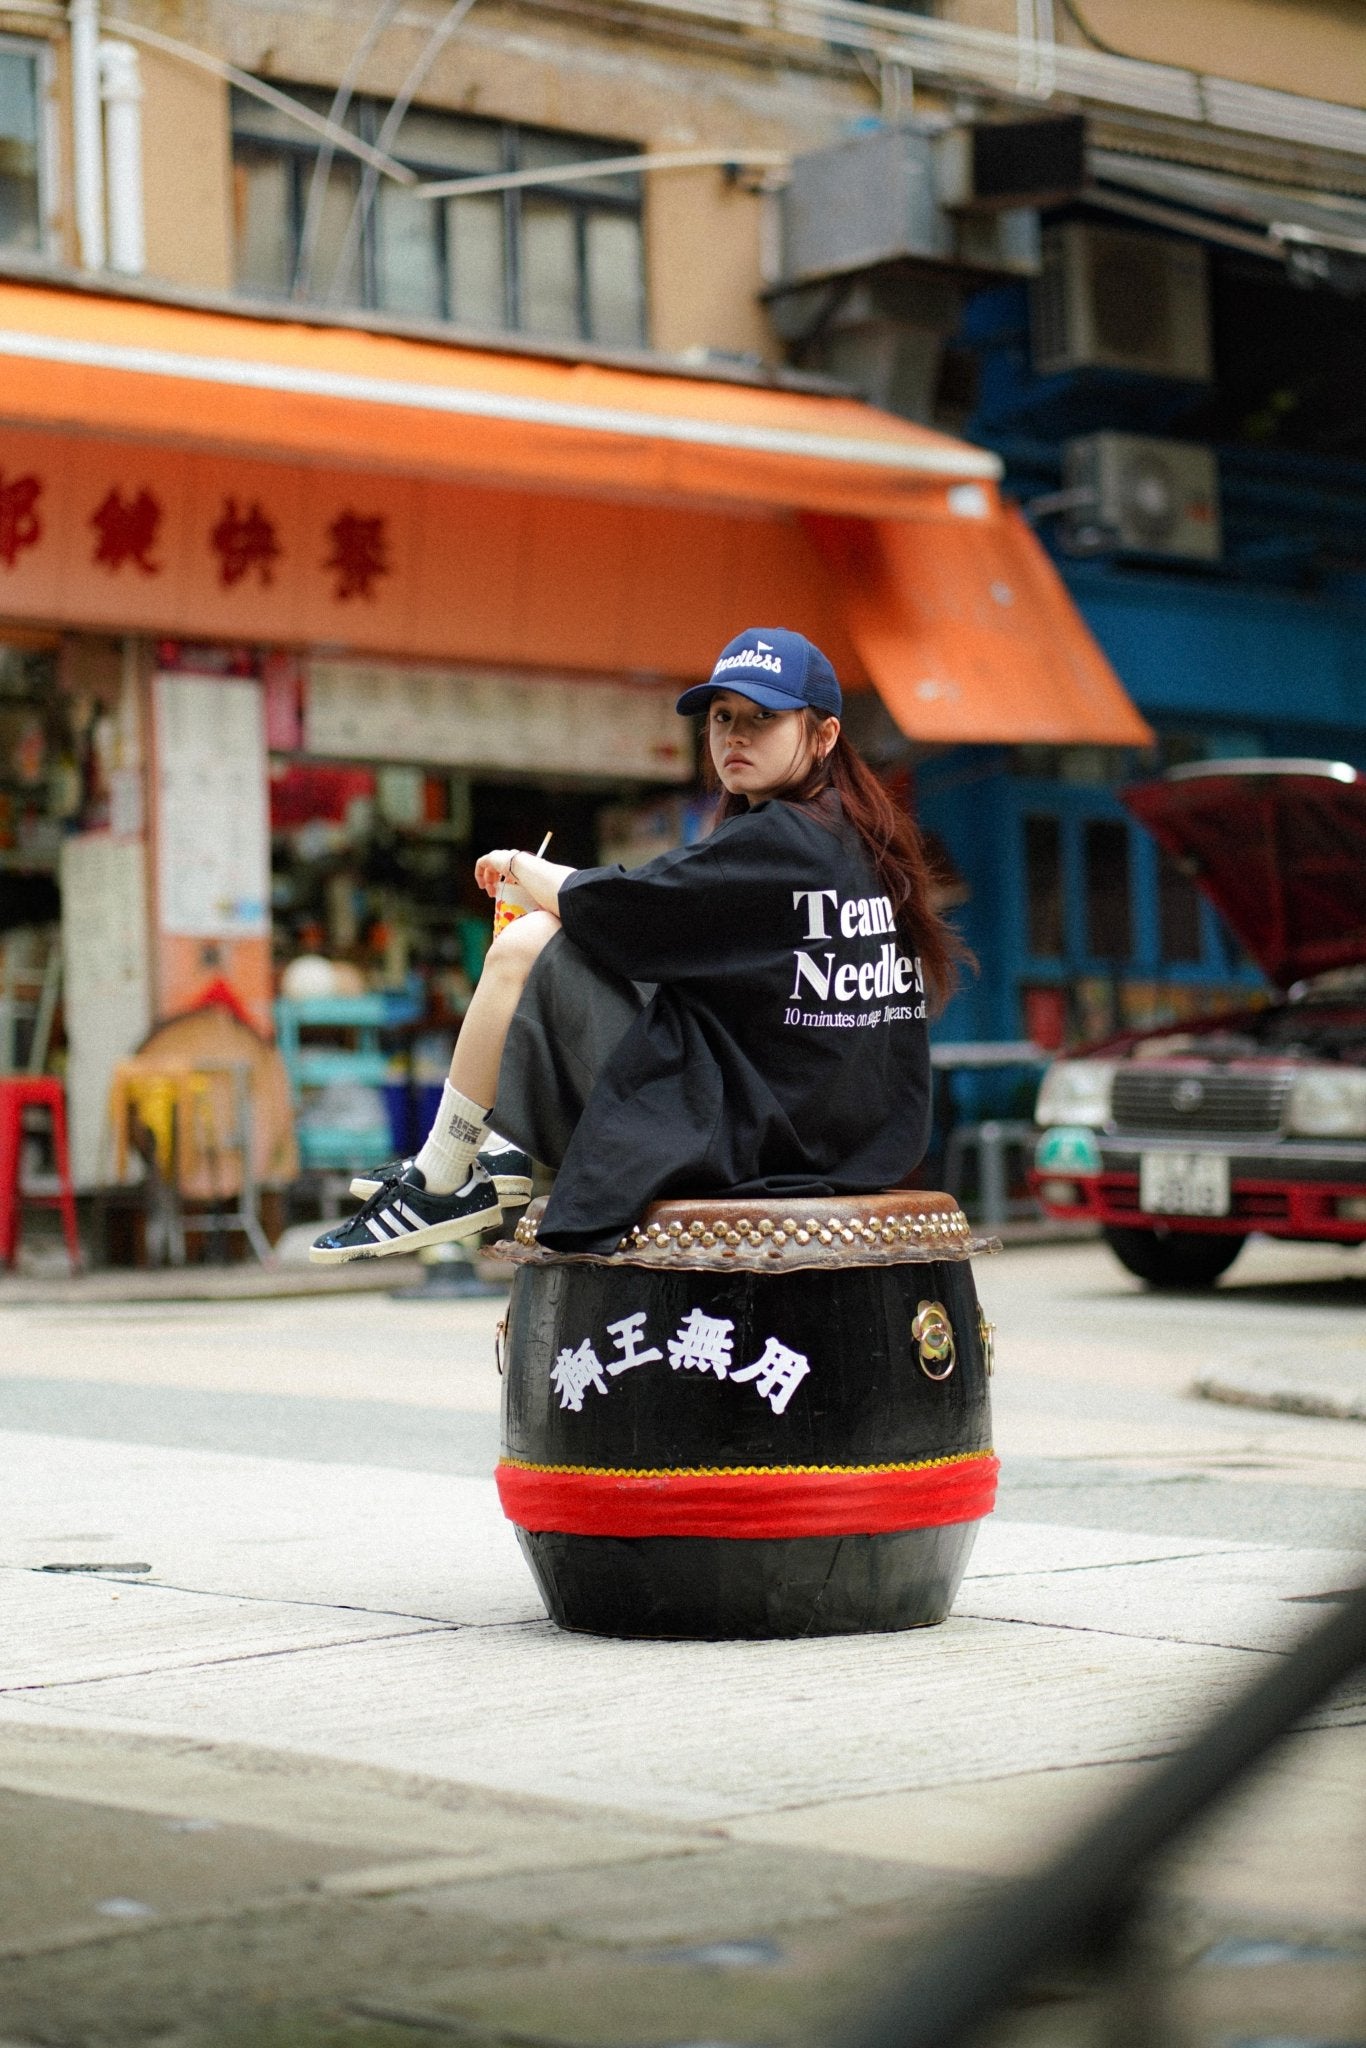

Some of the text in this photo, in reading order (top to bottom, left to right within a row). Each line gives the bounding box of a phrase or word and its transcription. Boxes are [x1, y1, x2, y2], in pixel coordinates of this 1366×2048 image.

[792, 889, 896, 939] Team
[783, 1007, 800, 1025] 10
[802, 1010, 855, 1028] minutes
